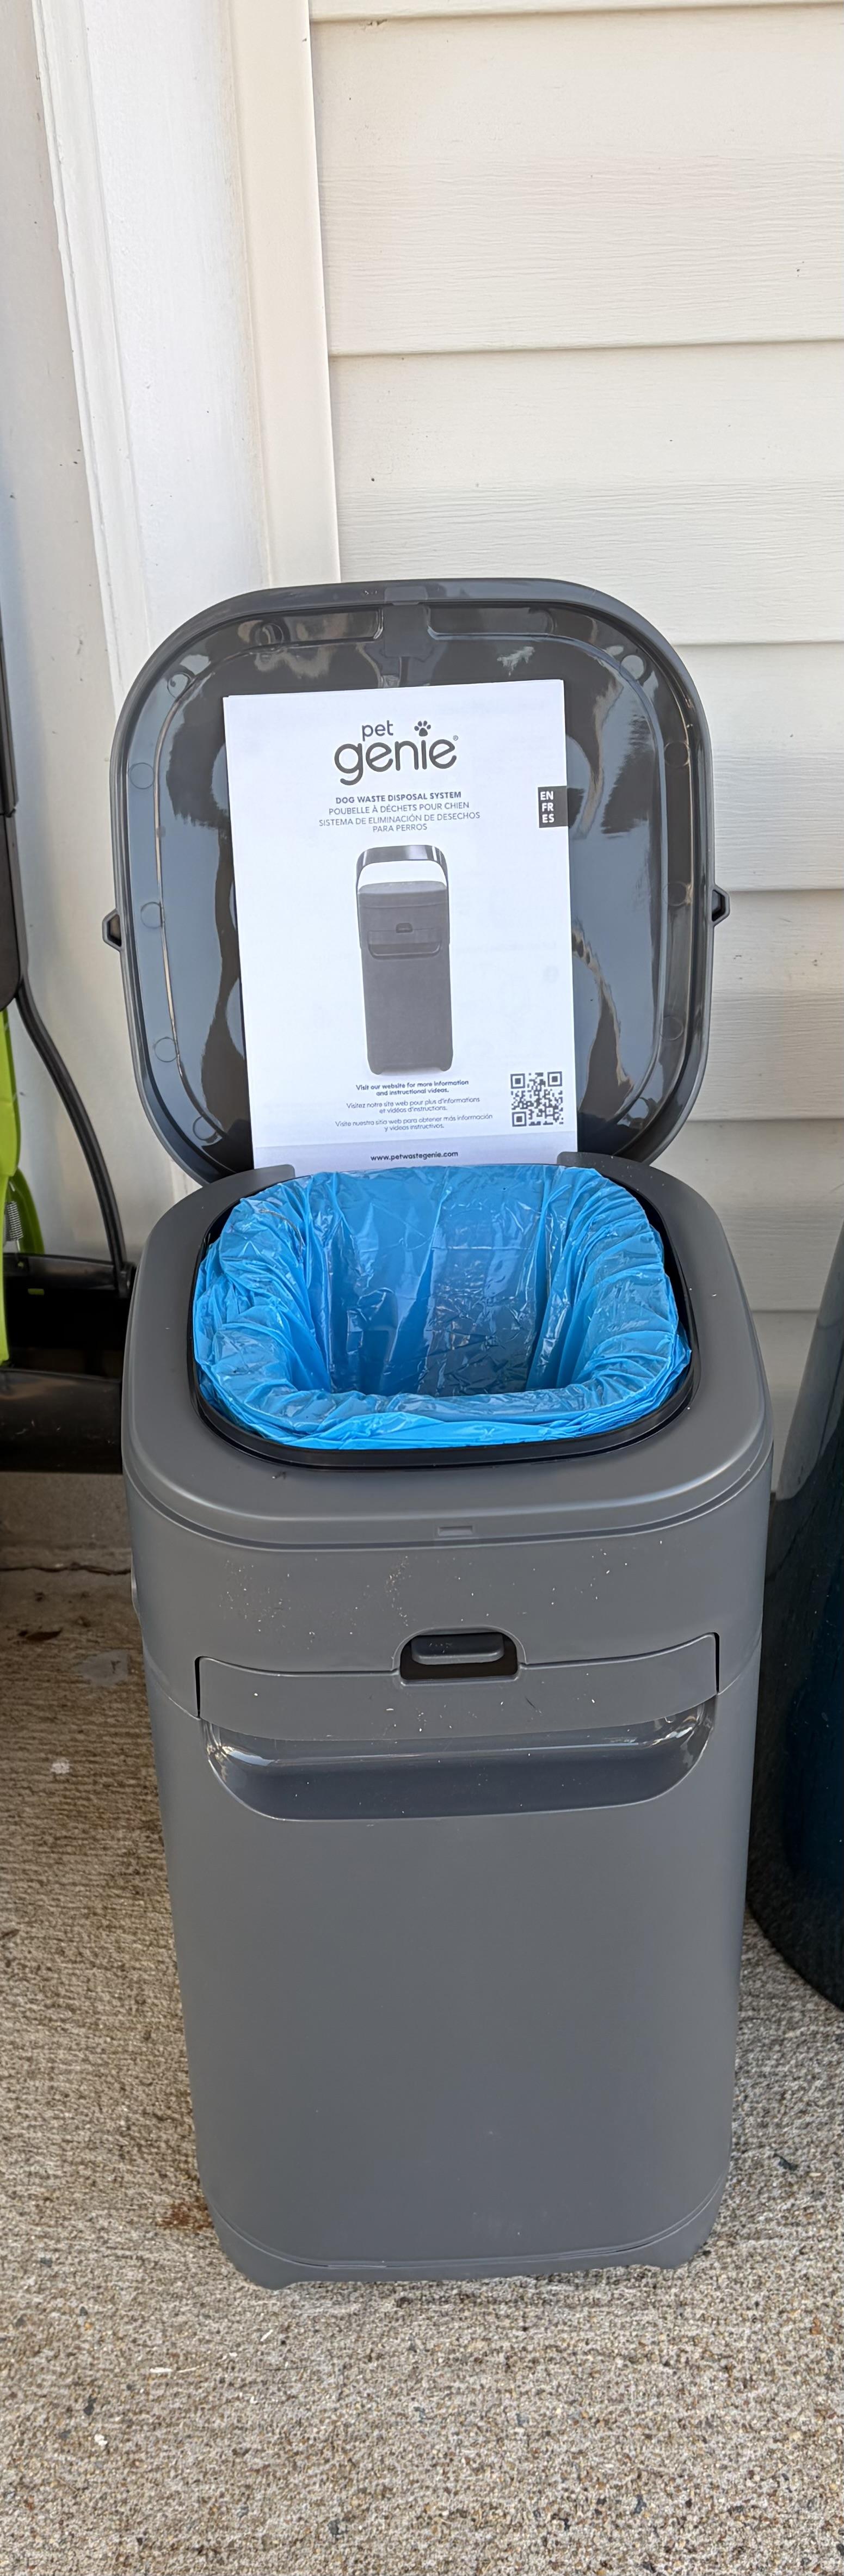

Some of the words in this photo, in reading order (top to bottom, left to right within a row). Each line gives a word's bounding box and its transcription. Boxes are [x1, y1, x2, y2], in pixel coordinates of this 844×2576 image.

[361, 720, 394, 742] pet
[335, 796, 355, 804] DOG
[356, 795, 386, 803] WASTE
[387, 792, 428, 802] DISPOSAL
[429, 791, 461, 800] SYSTEM
[540, 790, 554, 801] EN
[329, 806, 370, 815] POUBELLE
[372, 804, 379, 813] À
[380, 804, 417, 813] DÉCHETS
[419, 803, 442, 811] POUR
[444, 801, 470, 810] CHIEN
[541, 802, 554, 812] FR
[319, 818, 354, 827] SISTEMA
[355, 817, 367, 825] DE
[367, 812, 422, 825] ELIMINACIÓN
[424, 814, 435, 822] DE
[436, 811, 480, 821] DESECHOS
[542, 813, 555, 823] ES
[396, 823, 428, 832] PERROS
[389, 1087, 427, 1096] instructional
[370, 1151, 459, 1162] www.petwastegenie.com
